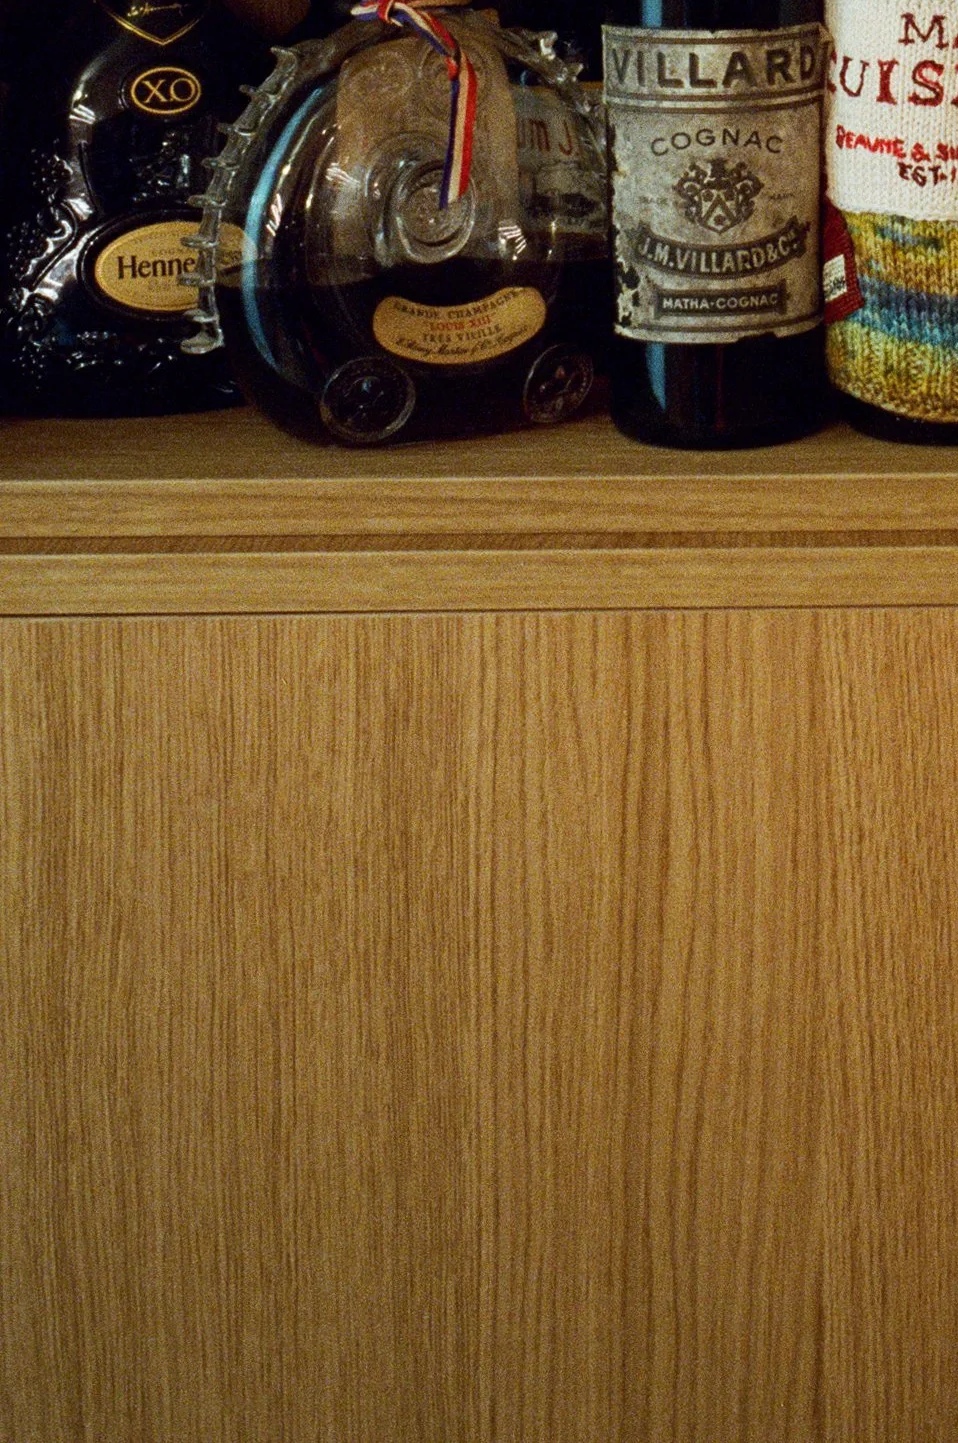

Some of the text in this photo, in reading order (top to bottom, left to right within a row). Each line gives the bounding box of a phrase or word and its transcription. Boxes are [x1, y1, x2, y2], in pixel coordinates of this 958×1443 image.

[612, 45, 817, 89] VILLARD
[650, 128, 784, 157] COGNAC
[835, 124, 905, 159] BEAUNE
[911, 142, 931, 163] &
[116, 254, 200, 281] Henne
[392, 289, 521, 319] GRANDE CHAMPAGNE
